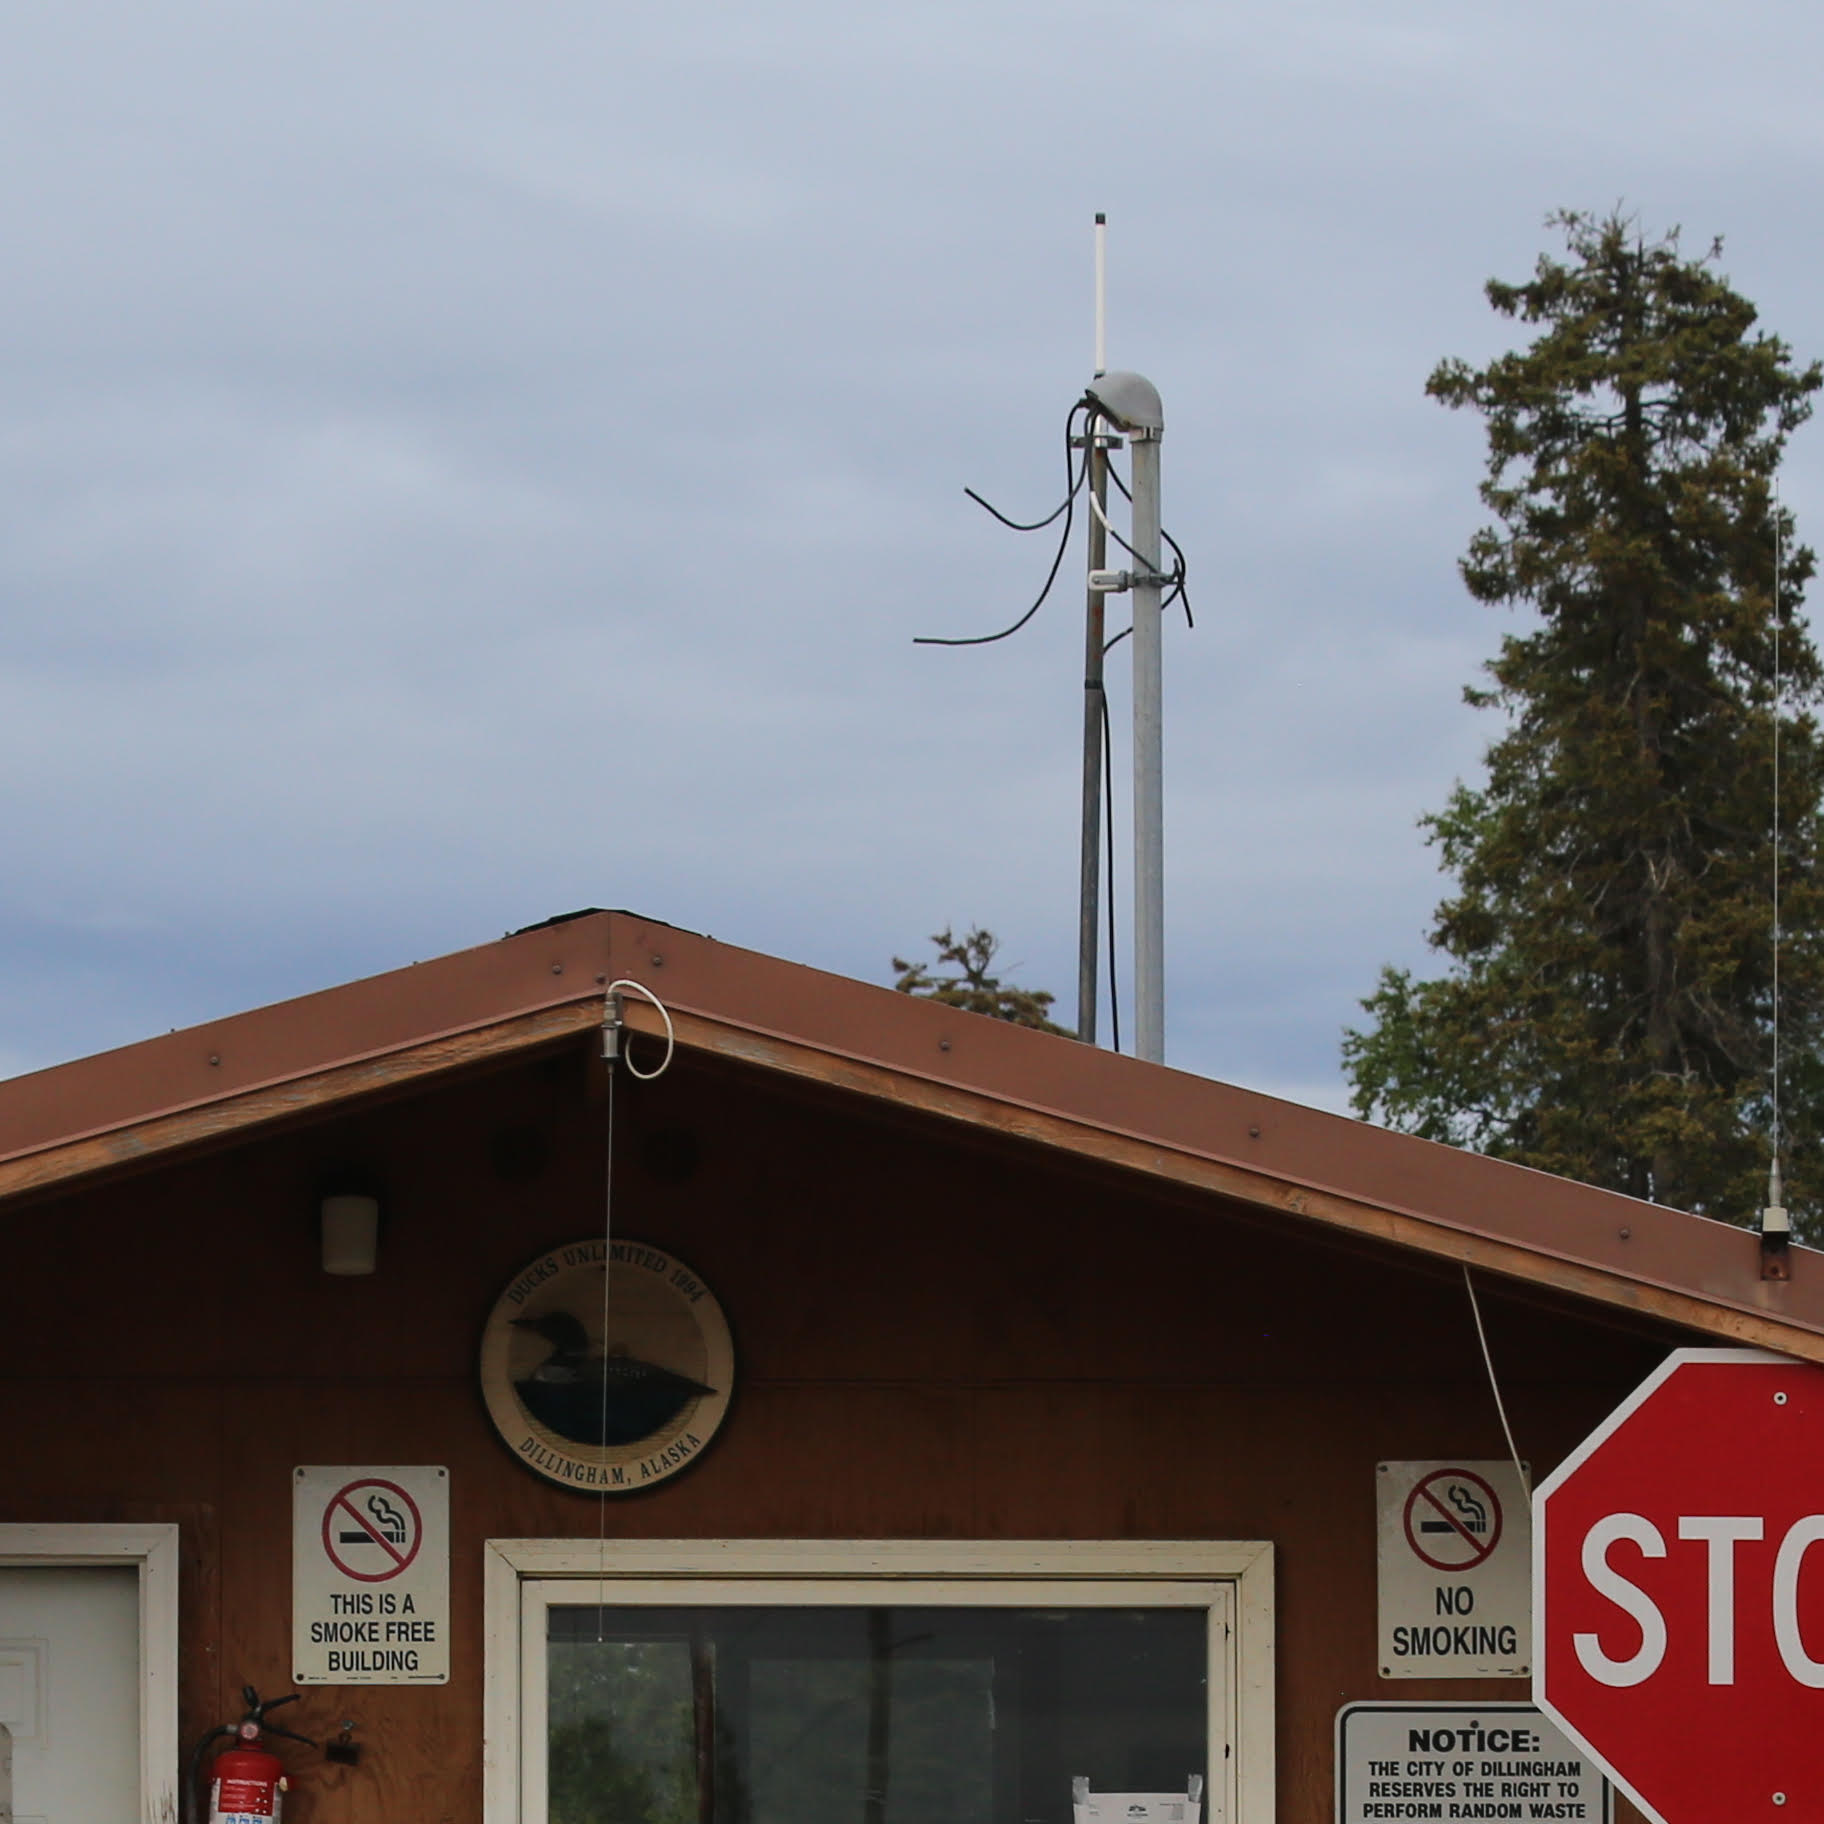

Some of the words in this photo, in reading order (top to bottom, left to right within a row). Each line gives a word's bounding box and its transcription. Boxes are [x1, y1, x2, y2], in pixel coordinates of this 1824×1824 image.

[507, 1258, 559, 1304] DUCKS
[519, 1436, 631, 1486] DILLINGHAM,
[641, 1432, 700, 1478] ALASKA
[330, 1594, 372, 1614] THIS
[380, 1594, 395, 1614] IS
[402, 1594, 415, 1614] A
[1436, 1586, 1474, 1615] NO
[311, 1622, 379, 1643] SMOKE
[386, 1622, 435, 1642] FREE
[1392, 1626, 1517, 1656] SMOKING
[328, 1651, 418, 1671] BUILDING
[1409, 1730, 1540, 1753] NOTICE:
[1369, 1762, 1399, 1776] THE
[1407, 1762, 1445, 1777] CITY
[1453, 1762, 1474, 1777] OF
[1481, 1762, 1581, 1777] DILLINGHAM
[1369, 1783, 1456, 1798] RESERVES
[1464, 1783, 1494, 1797] THE
[1501, 1783, 1550, 1797] RIGHT
[1559, 1783, 1579, 1797] TO
[1363, 1804, 1442, 1818] PERFORM
[1449, 1804, 1522, 1818] RANDOM
[1530, 1804, 1585, 1818] WASTE
